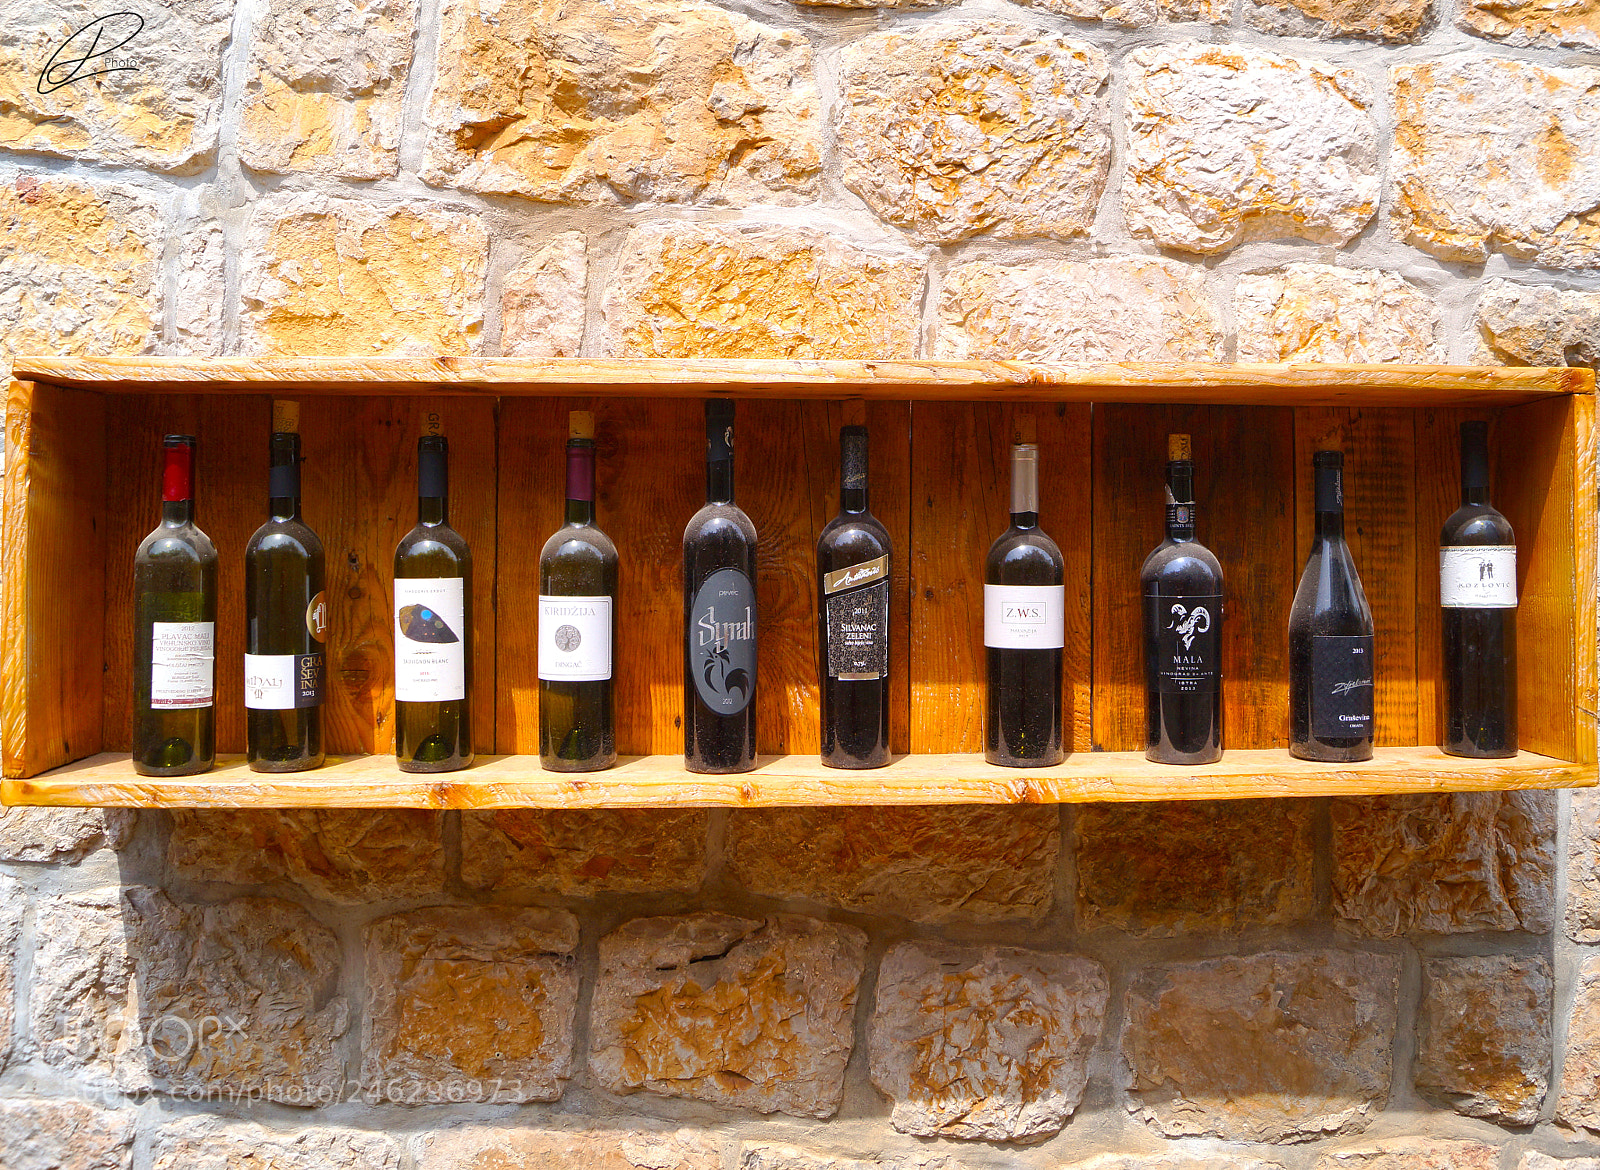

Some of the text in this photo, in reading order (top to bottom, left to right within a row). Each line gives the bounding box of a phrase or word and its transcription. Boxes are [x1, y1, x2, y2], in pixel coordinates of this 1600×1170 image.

[544, 606, 596, 616] KIRIDŽIJA
[853, 607, 868, 615] 2011
[1006, 607, 1042, 618] Z.W.S.
[697, 605, 755, 654] Syrah
[840, 623, 877, 632] SILVANAC
[846, 632, 872, 640] ZELENI
[300, 656, 323, 669] GRA
[1173, 655, 1203, 664] MALA
[300, 680, 319, 690] INA
